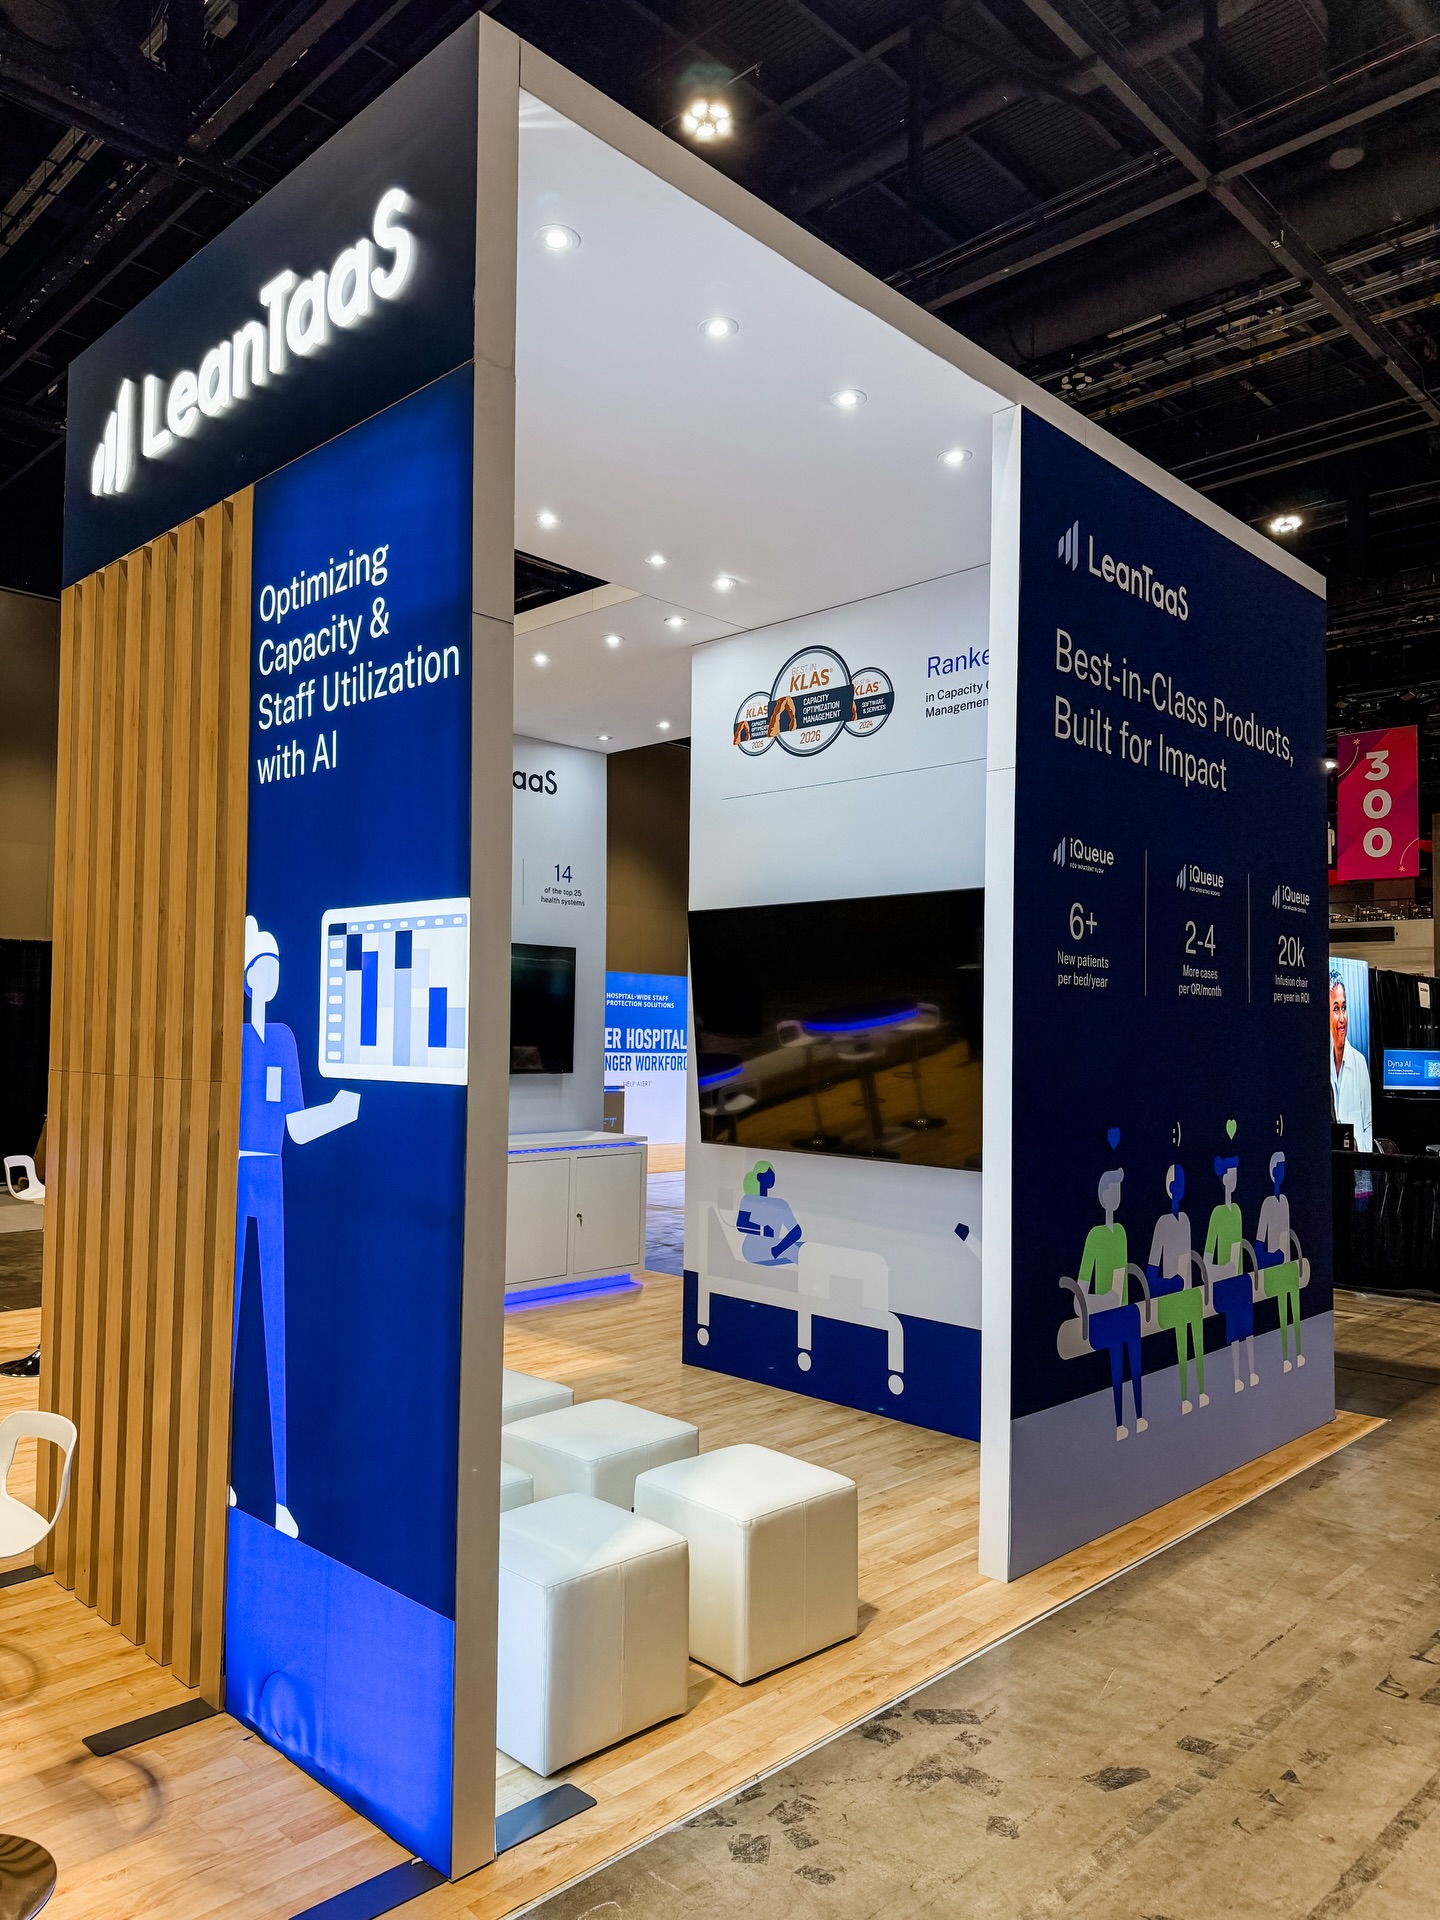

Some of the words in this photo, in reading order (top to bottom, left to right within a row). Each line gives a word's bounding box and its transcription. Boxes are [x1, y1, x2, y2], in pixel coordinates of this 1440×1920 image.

[143, 187, 415, 458] LeanTaaS
[259, 544, 389, 624] Optimizing
[1088, 535, 1189, 621] LeanTaaS
[258, 614, 363, 676] Capacity
[369, 596, 390, 638] &
[791, 665, 808, 675] BEST
[810, 663, 817, 671] IN
[927, 646, 989, 678] Ranke
[258, 679, 316, 730] Staff
[323, 644, 460, 712] Utilization
[925, 692, 935, 703] in
[937, 683, 983, 700] Capacity
[802, 694, 829, 706] CAPACITY
[802, 700, 840, 715] OPTIMIZATION
[1056, 628, 1208, 728] Best-in-Class
[1213, 697, 1294, 767] Products,
[802, 710, 841, 724] MANAGEMENT
[867, 704, 886, 714] SERVICES
[925, 698, 988, 718] Managemen
[800, 729, 821, 744] 2026
[1054, 695, 1112, 755] Built
[1119, 721, 1152, 766] for
[1159, 733, 1227, 792] Impact
[257, 740, 305, 784] with
[312, 730, 337, 772] AI
[1069, 837, 1114, 866] iQueue
[554, 863, 573, 884] 14
[1189, 864, 1224, 888] iQueue
[540, 896, 560, 904] health
[561, 898, 585, 907] systems
[544, 887, 551, 895] of
[552, 887, 562, 895] the
[563, 889, 573, 897] top
[574, 889, 582, 897] 25
[1282, 885, 1310, 906] iQueue
[1069, 902, 1098, 941] 6+
[1185, 920, 1216, 957] 2-4
[1057, 950, 1076, 966] New
[1077, 954, 1109, 969] patients
[1278, 934, 1306, 968] 20k
[1057, 973, 1071, 987] per
[1073, 971, 1109, 990] bed/year
[1183, 964, 1200, 977] More
[1200, 969, 1219, 980] cases
[1275, 974, 1296, 987] Infusion
[1296, 976, 1308, 988] chair
[606, 993, 651, 1001] HOSPITAL-WIDE
[1178, 984, 1190, 996] per
[1190, 983, 1222, 997] OR/month
[1273, 992, 1282, 1003] per
[1283, 993, 1294, 1003] year
[1294, 992, 1300, 1003] in
[1300, 992, 1310, 1003] ROI
[605, 1027, 622, 1049] ER
[626, 1028, 687, 1049] HOSPITAL
[605, 1055, 632, 1071] NGER
[1387, 1060, 1404, 1069] Dyna
